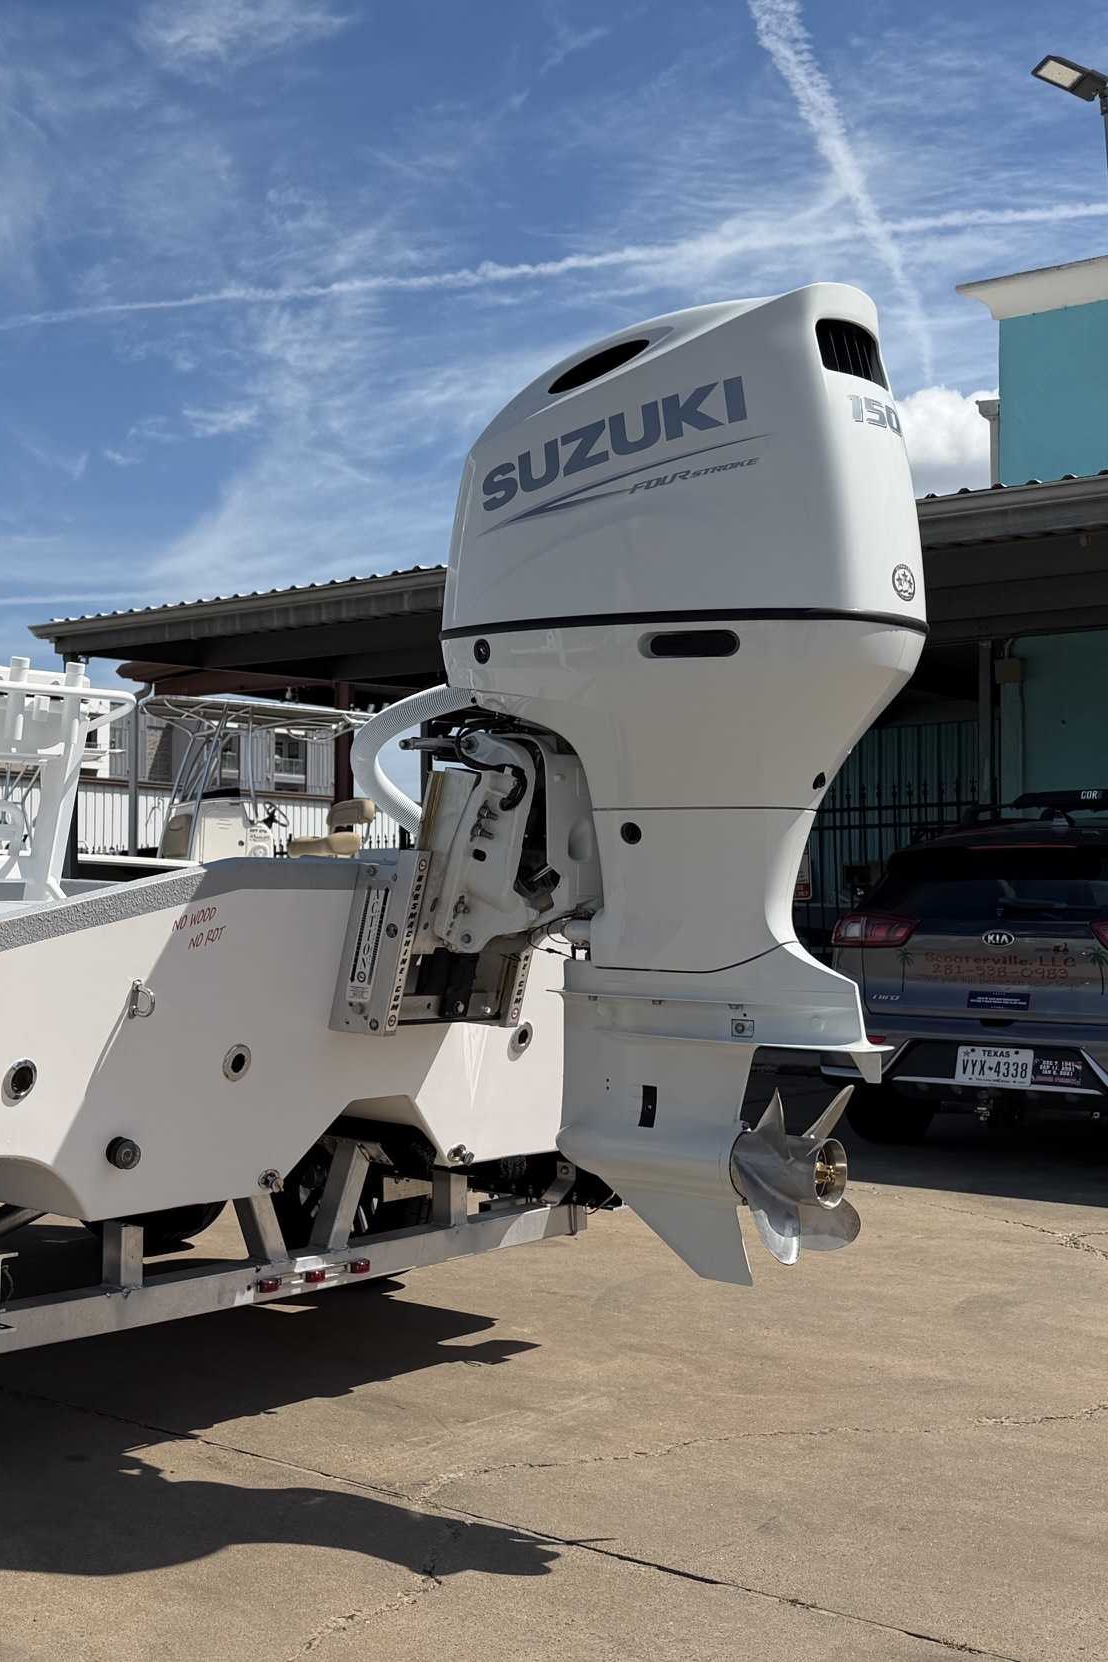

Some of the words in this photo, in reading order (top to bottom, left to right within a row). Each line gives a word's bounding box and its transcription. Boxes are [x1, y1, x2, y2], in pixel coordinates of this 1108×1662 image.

[846, 394, 903, 437] 150
[482, 376, 748, 511] SUZUKI
[172, 914, 188, 932] NO
[190, 906, 217, 928] WOOD
[188, 932, 204, 950] NO
[204, 925, 227, 946] ROT
[987, 934, 1010, 944] KIA
[982, 1049, 1011, 1058] TEXAS
